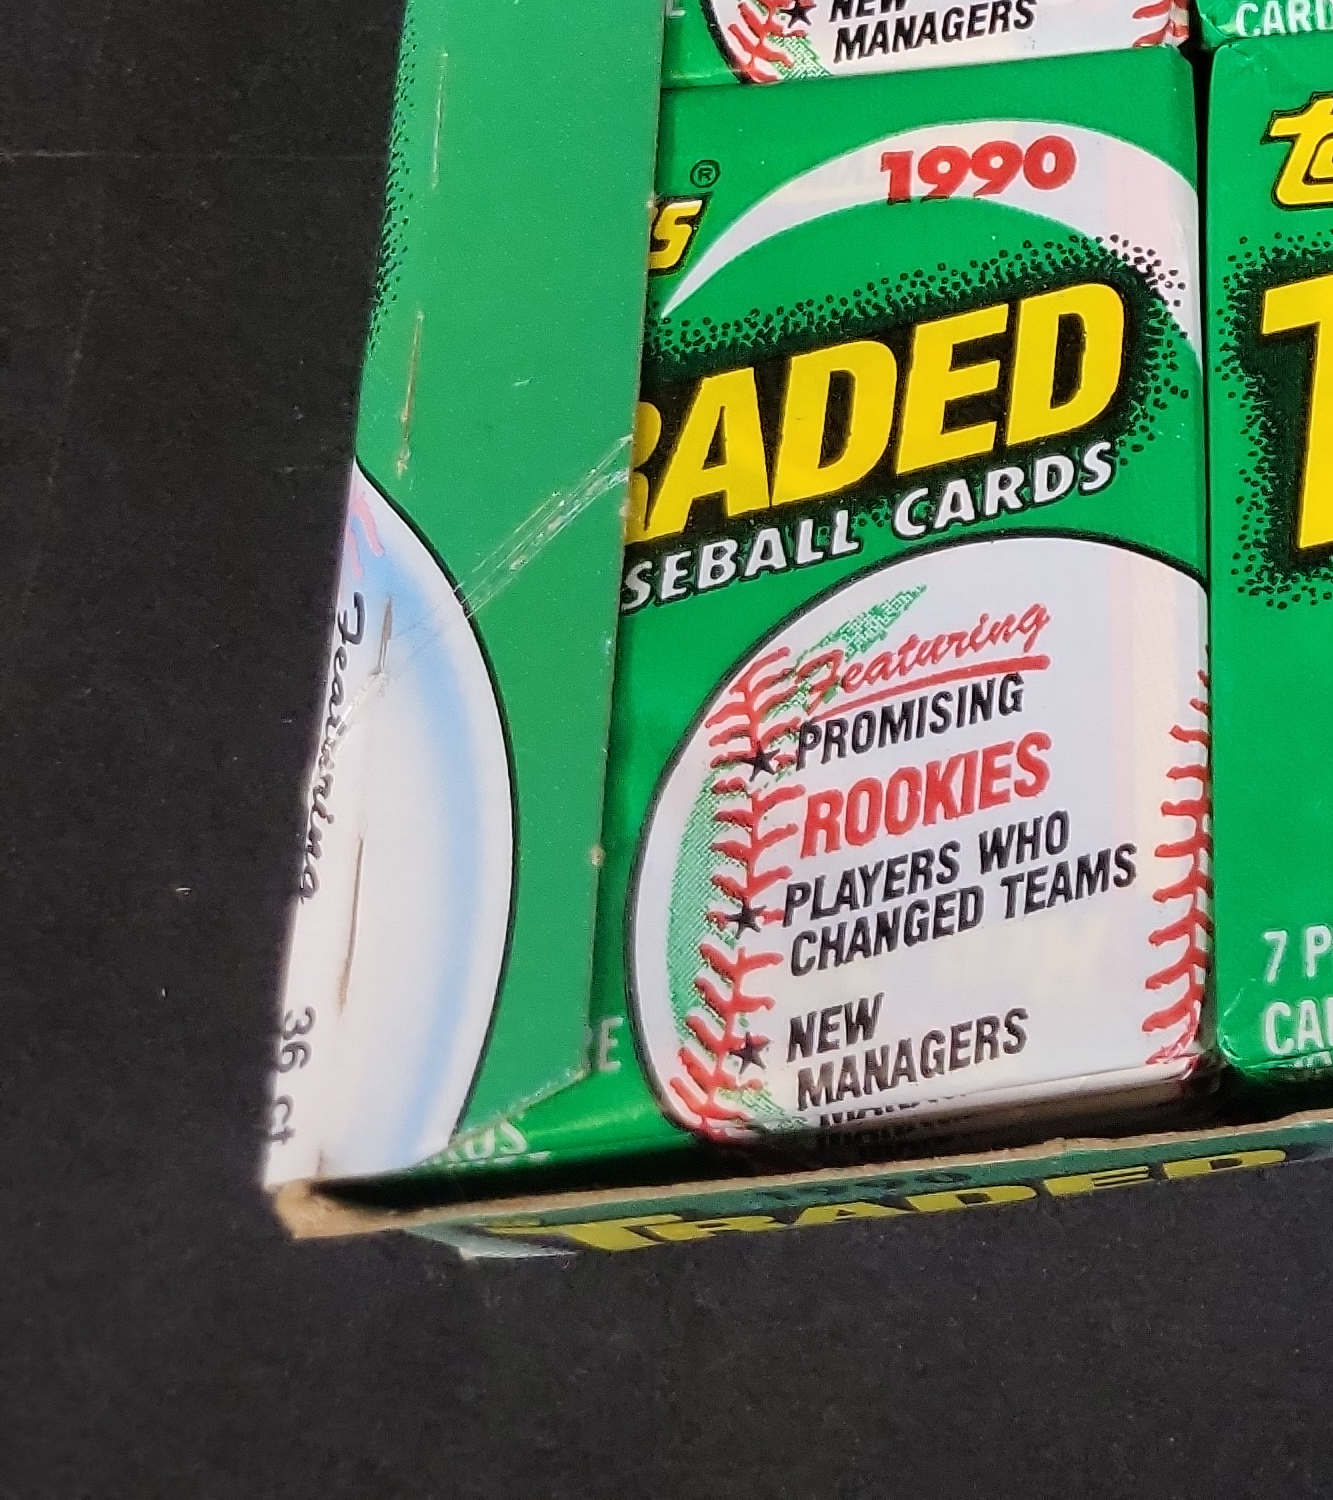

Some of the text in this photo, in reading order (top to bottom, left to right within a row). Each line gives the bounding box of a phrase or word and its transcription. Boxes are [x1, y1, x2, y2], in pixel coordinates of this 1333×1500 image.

[880, 136, 1076, 205] 1990
[894, 441, 1115, 537] CARDS
[795, 602, 1051, 703] Featuring
[795, 673, 1024, 770] PROMISING
[801, 731, 1052, 859] ROOKIES
[783, 810, 1069, 928] PLAYERS WHO
[791, 844, 1137, 977] CHANGED TEAMS
[1263, 931, 1287, 983] 7
[787, 992, 884, 1062] NEW
[797, 1008, 1029, 1111] MANAGERS
